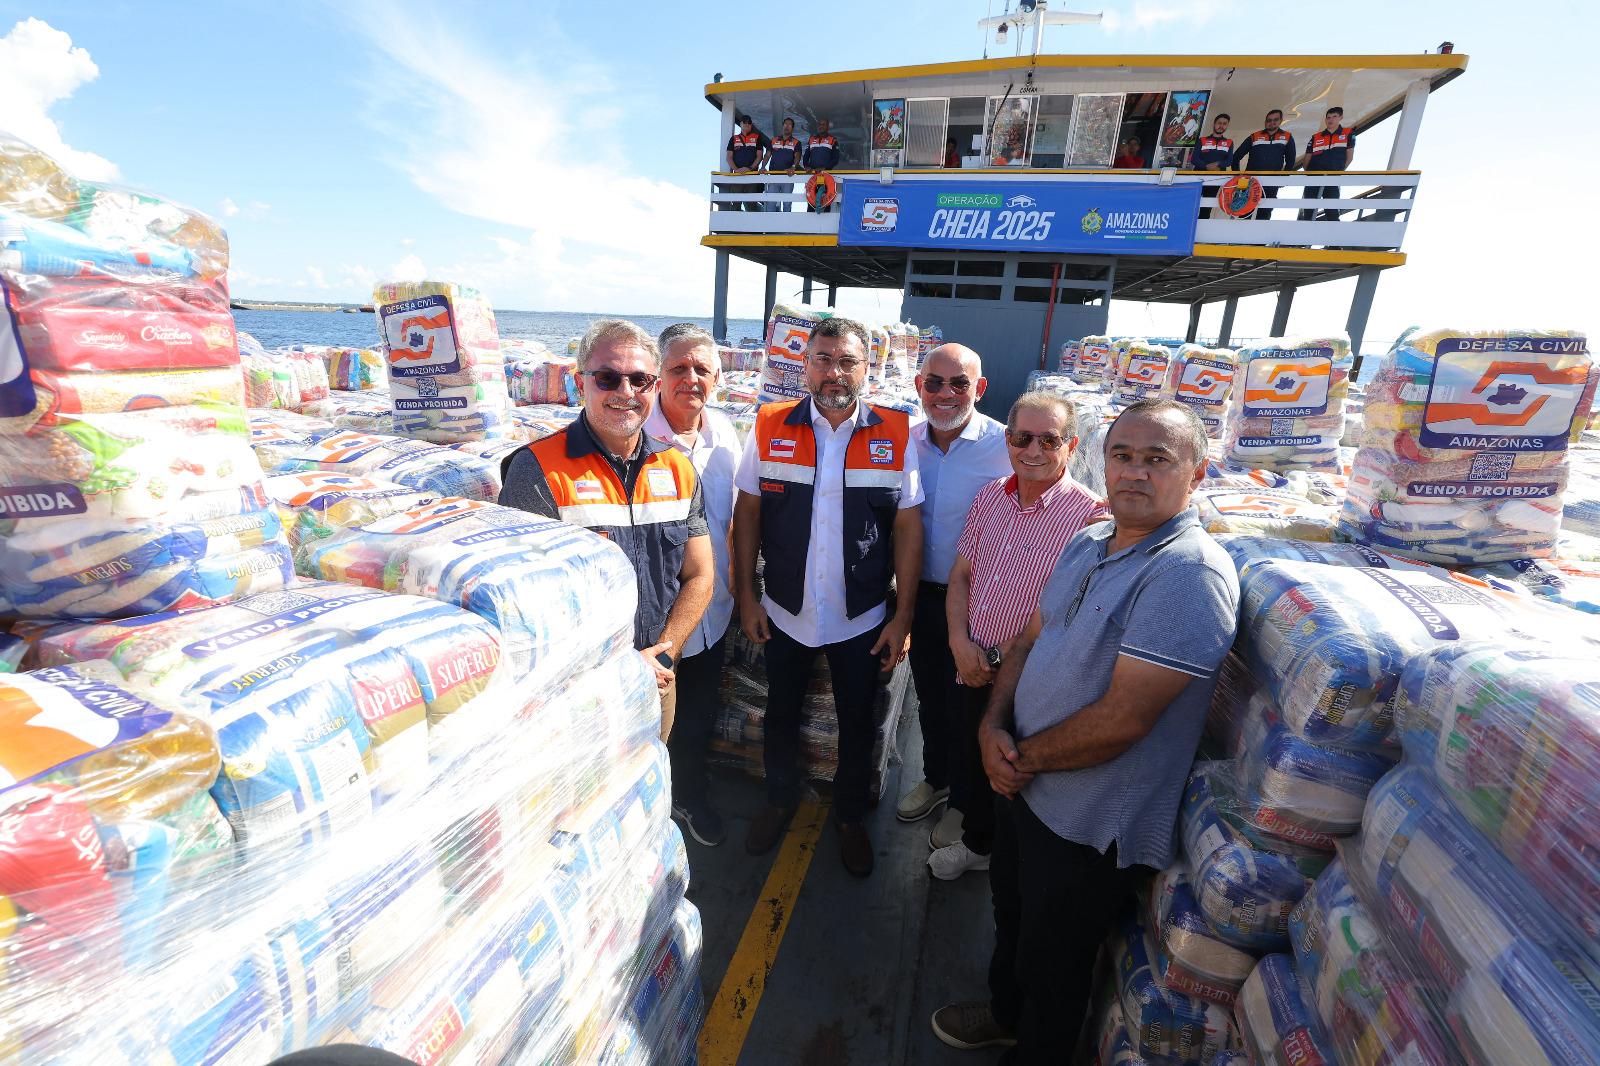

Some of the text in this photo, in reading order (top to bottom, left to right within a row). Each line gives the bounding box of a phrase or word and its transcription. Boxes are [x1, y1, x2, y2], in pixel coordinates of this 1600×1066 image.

[939, 194, 999, 206] OPERAÇÃO
[929, 209, 1055, 241] CHEIA 2025
[1105, 212, 1169, 228] AMAZONAS
[386, 298, 437, 314] DEFESA CIVIL
[1458, 340, 1587, 352] DEFESA CIVIL
[1260, 349, 1322, 358] DEFESA CIVIL
[404, 365, 447, 375] AMAZONAS
[774, 363, 806, 373] AMAZONA
[396, 399, 464, 409] VENDA PROIBIDA
[1257, 408, 1311, 417] AMAZONAS
[1274, 437, 1318, 446] PROIBIDA
[1449, 436, 1544, 449] AMAZONAS
[1414, 484, 1551, 497] VENDA PROIBIDA
[461, 527, 517, 545] VENDA
[1395, 585, 1449, 633] PROIBIDA
[195, 617, 296, 652] VENDA
[437, 643, 500, 688] SUPERU
[358, 671, 423, 720] UPERU
[85, 689, 144, 719] CIVIL
